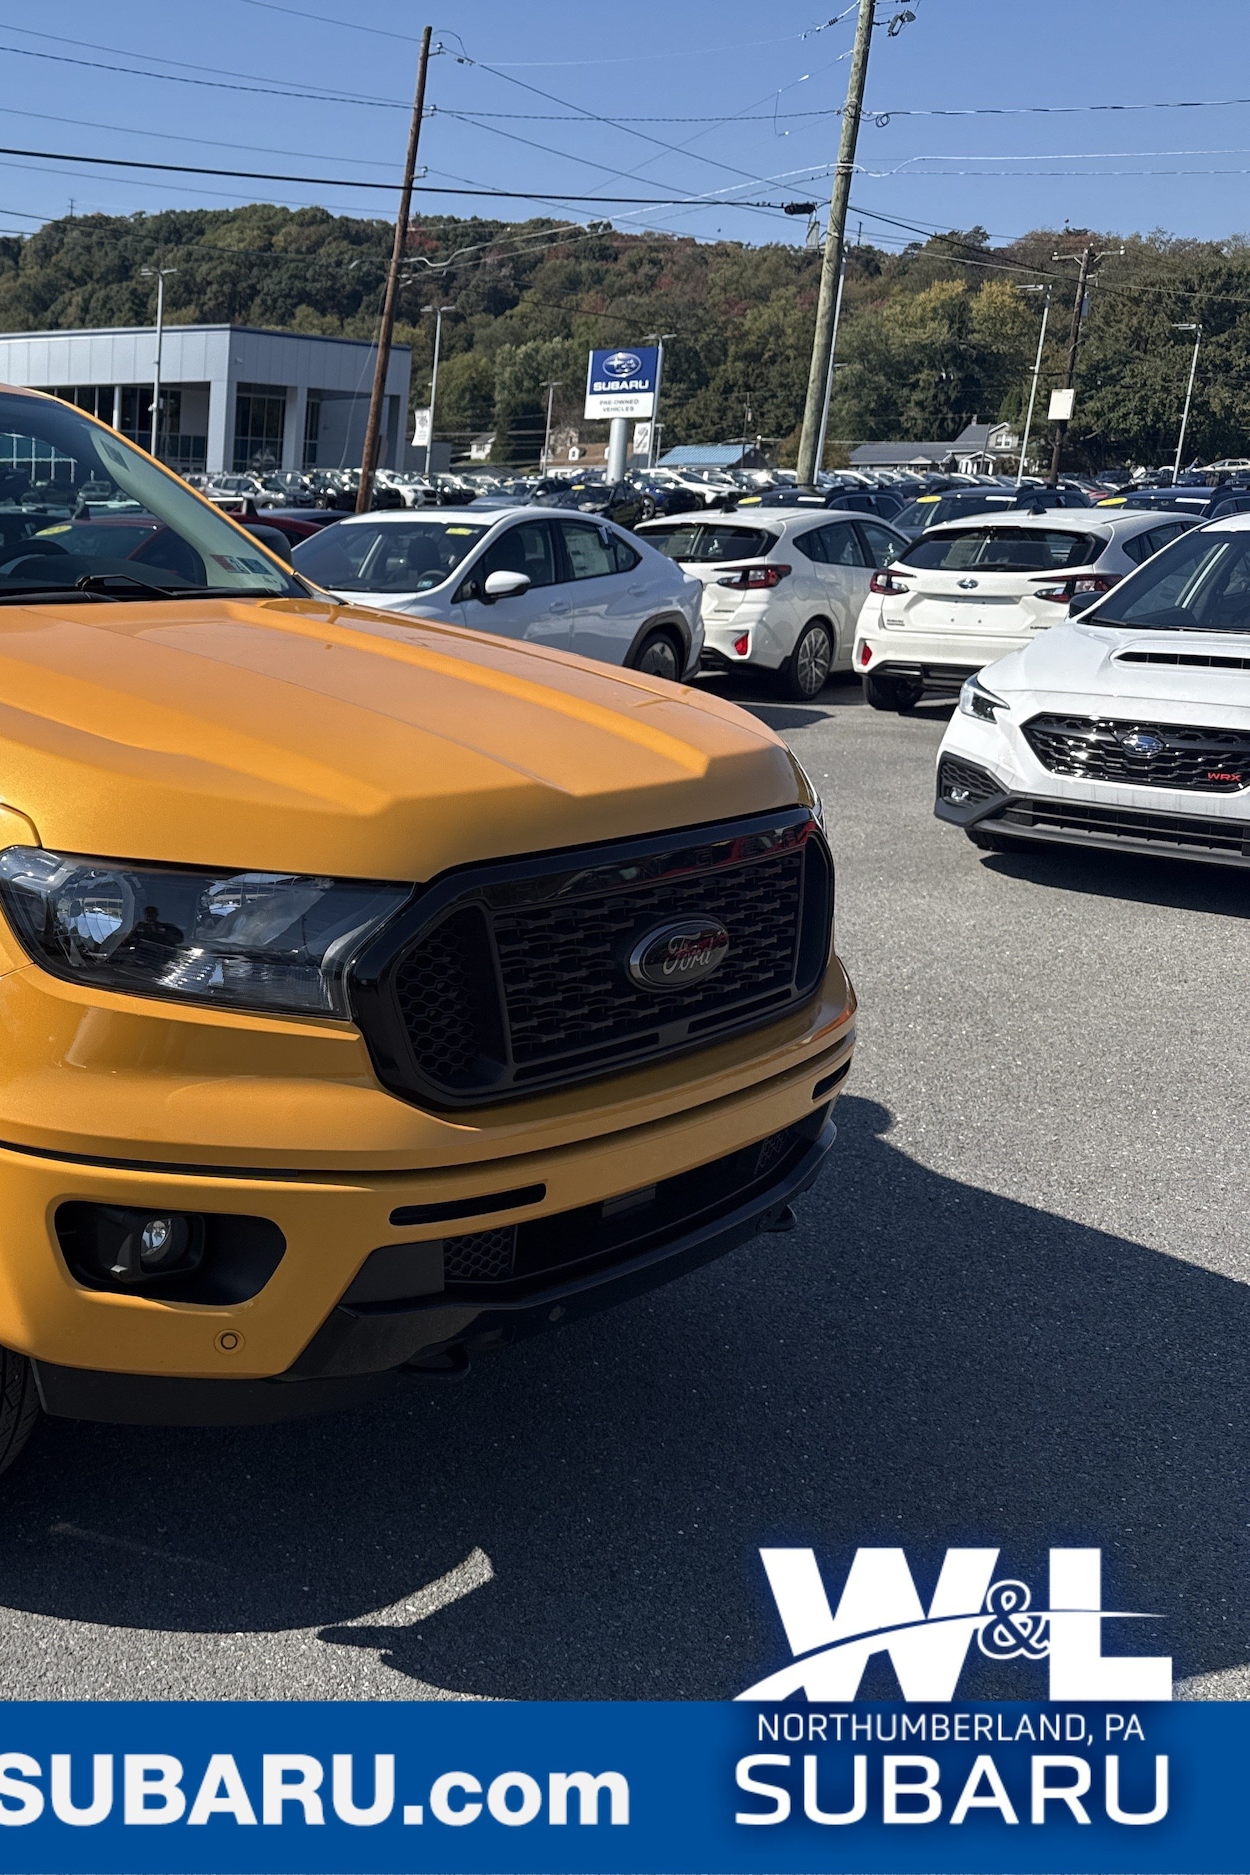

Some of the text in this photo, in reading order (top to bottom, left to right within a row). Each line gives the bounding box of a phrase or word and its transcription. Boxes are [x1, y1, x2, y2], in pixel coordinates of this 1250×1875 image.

[593, 379, 649, 392] SUBARU
[1207, 772, 1242, 782] WRX
[662, 932, 715, 975] Ford
